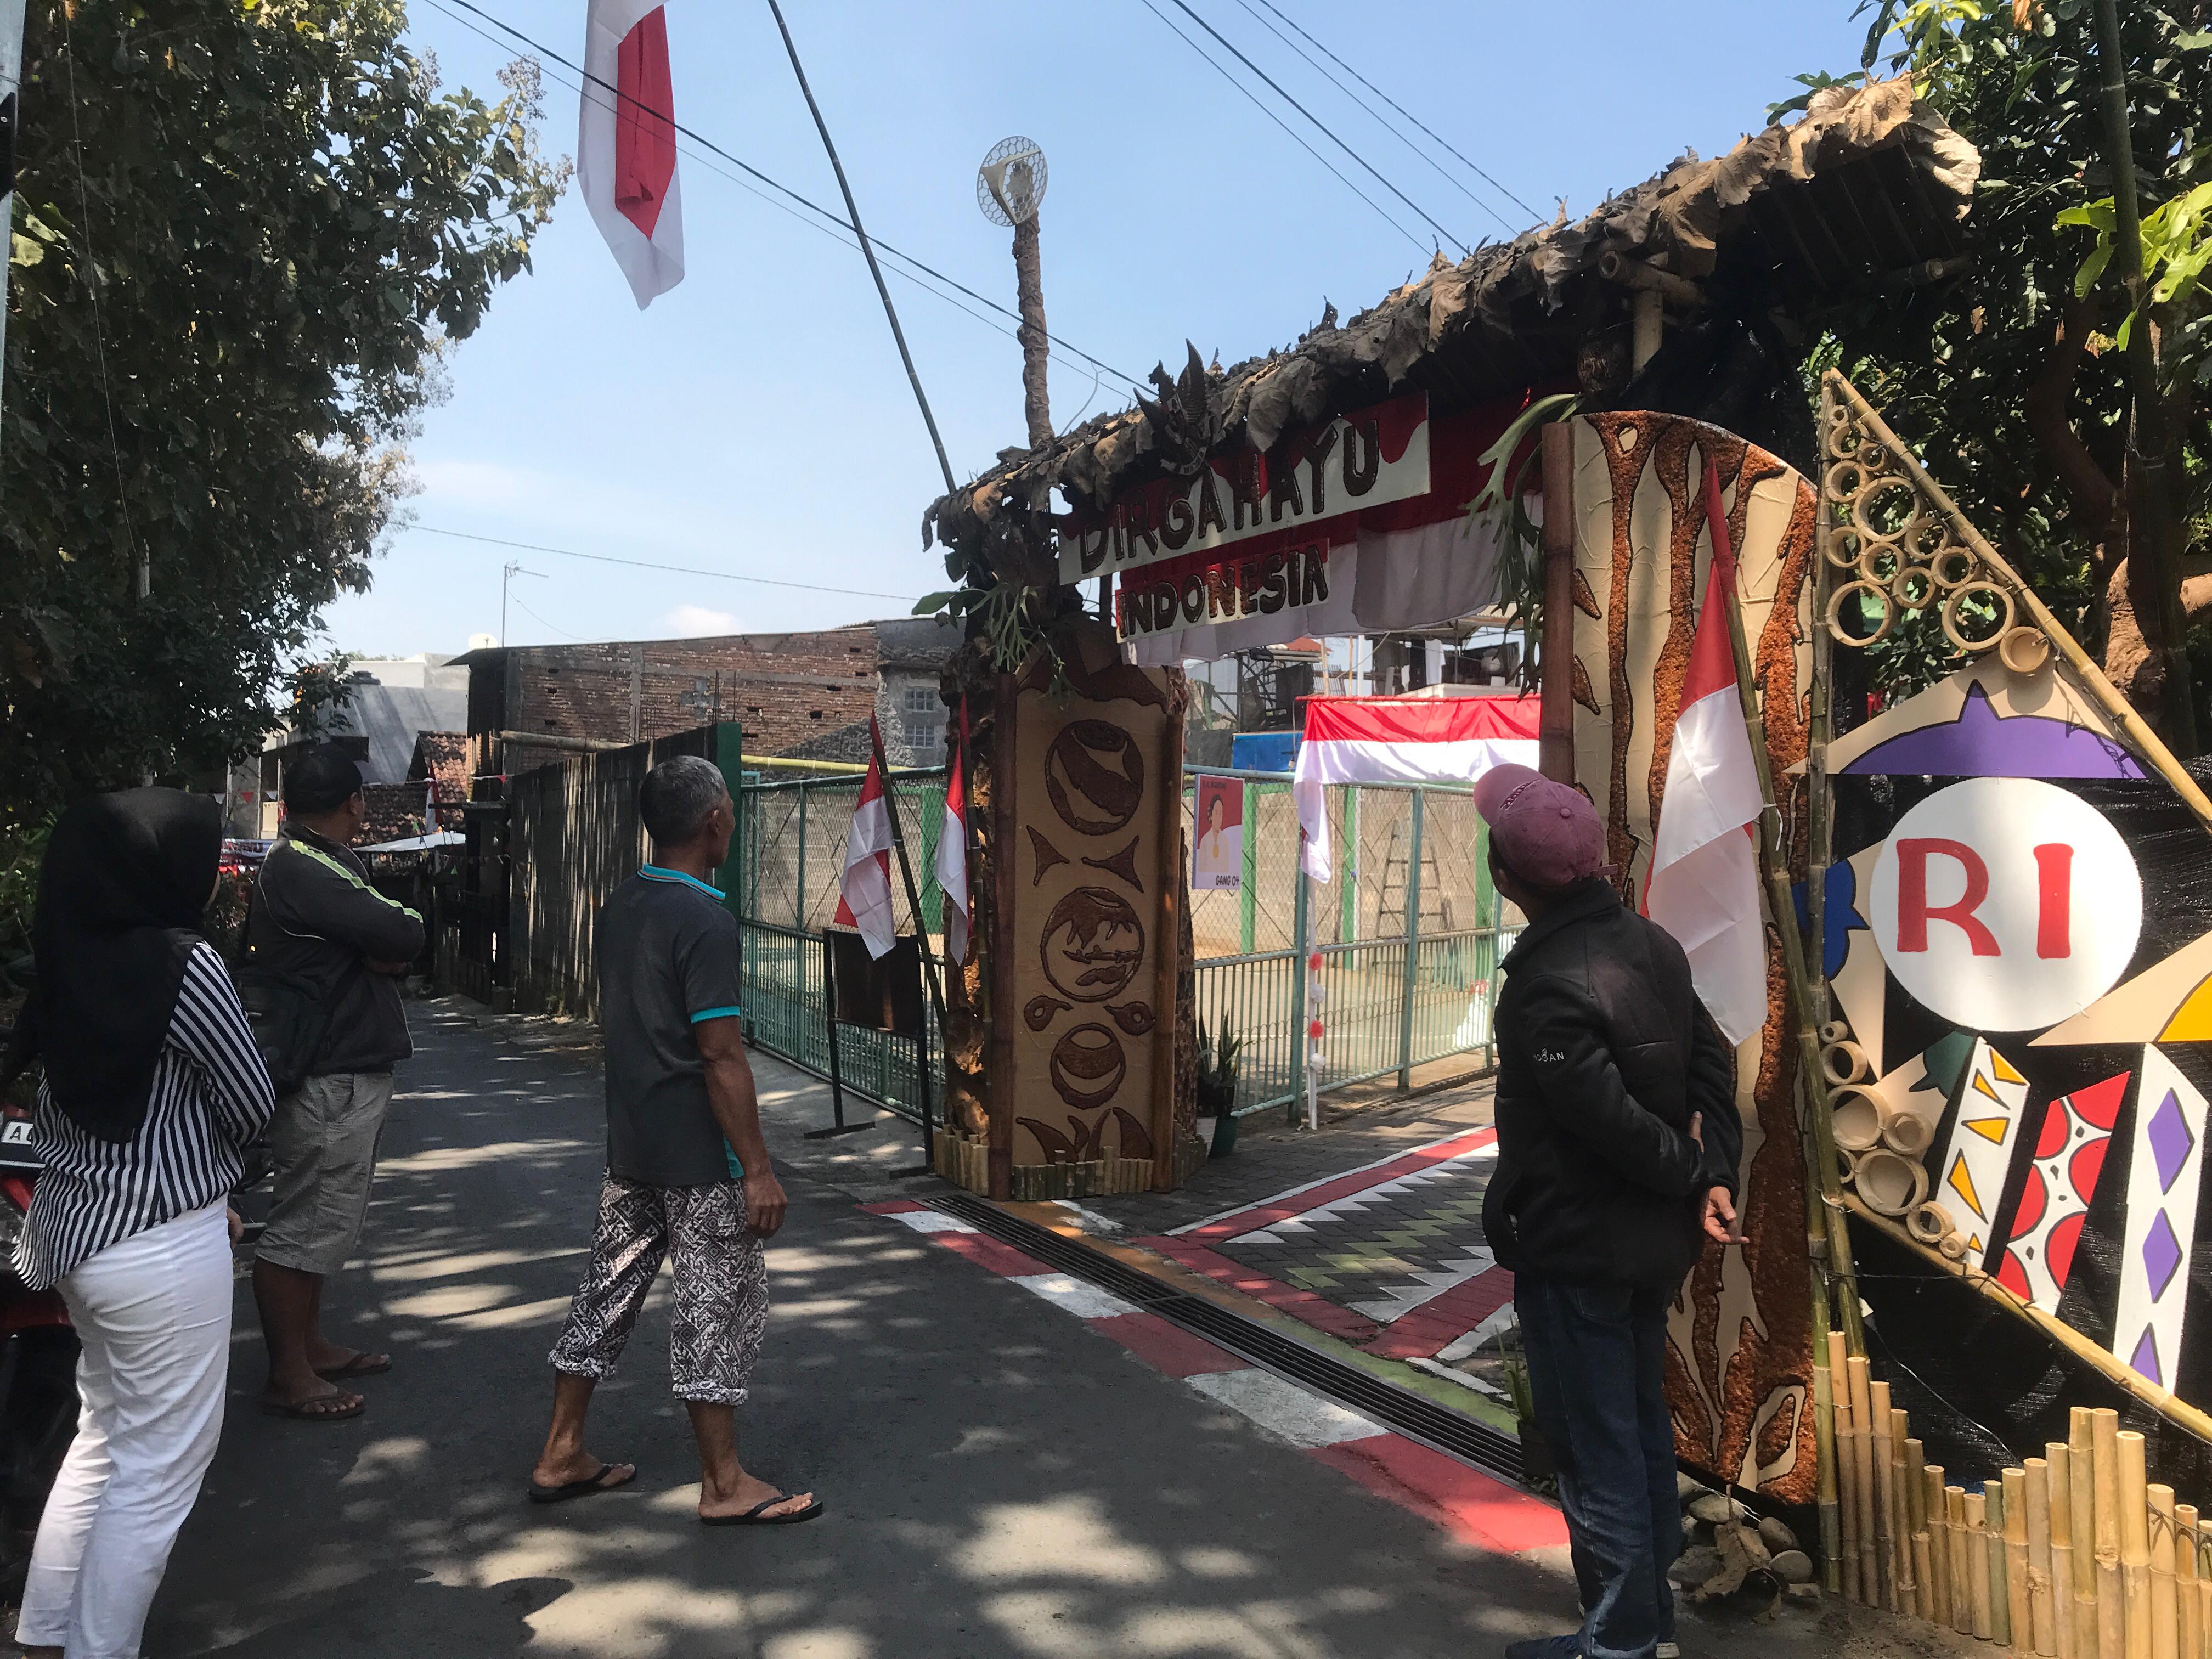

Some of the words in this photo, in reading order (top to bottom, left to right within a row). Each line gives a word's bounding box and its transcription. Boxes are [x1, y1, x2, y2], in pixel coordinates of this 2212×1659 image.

[1081, 420, 1379, 574] DIRGAHAYU
[1117, 545, 1328, 638] INDONESIA
[1216, 875, 1231, 886] GANG
[1896, 838, 2074, 959] RI
